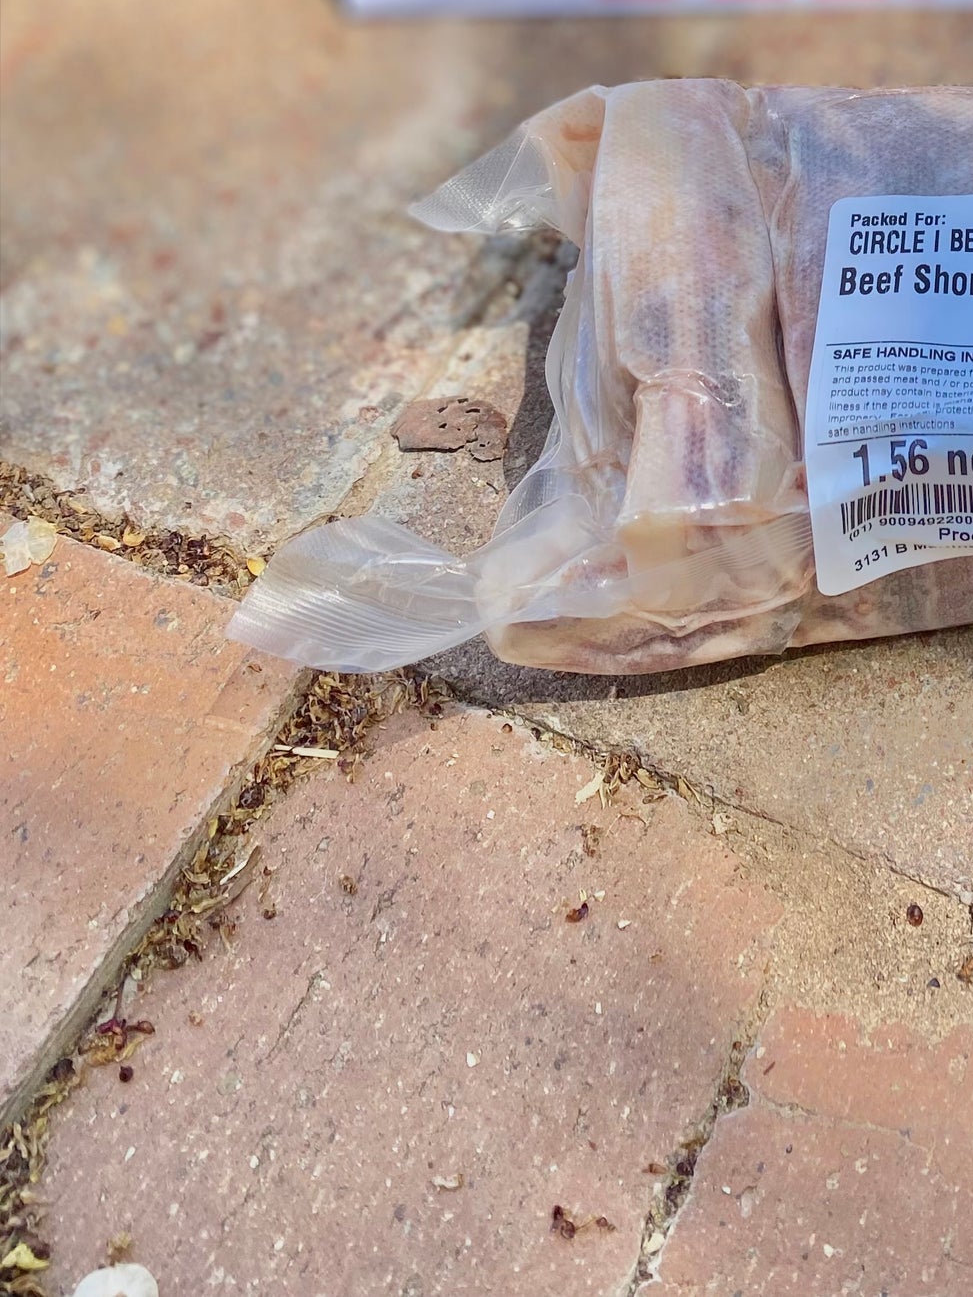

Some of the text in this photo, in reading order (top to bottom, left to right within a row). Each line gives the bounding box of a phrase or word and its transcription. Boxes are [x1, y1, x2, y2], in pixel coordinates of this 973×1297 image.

[850, 212, 946, 227] Packed For:
[850, 229, 925, 255] CIRCLE
[934, 230, 940, 252] I
[839, 264, 904, 296] Beef
[833, 347, 872, 360] SAFE
[876, 347, 956, 362] HANDLING
[834, 365, 855, 373] This
[857, 363, 896, 373] product
[898, 365, 917, 373] was
[920, 365, 969, 376] prepared
[832, 375, 851, 384] and
[854, 375, 890, 385] passed
[894, 376, 918, 384] meat
[921, 378, 940, 386] and
[831, 388, 869, 398] product
[872, 389, 893, 398] may
[896, 388, 932, 397] contain
[872, 402, 888, 410] the
[891, 401, 930, 411] product
[828, 428, 849, 438] safe
[853, 422, 896, 435] handling
[853, 439, 930, 487] 1.56
[849, 522, 872, 541] (01)
[855, 546, 888, 571] 3131
[895, 543, 908, 554] B
